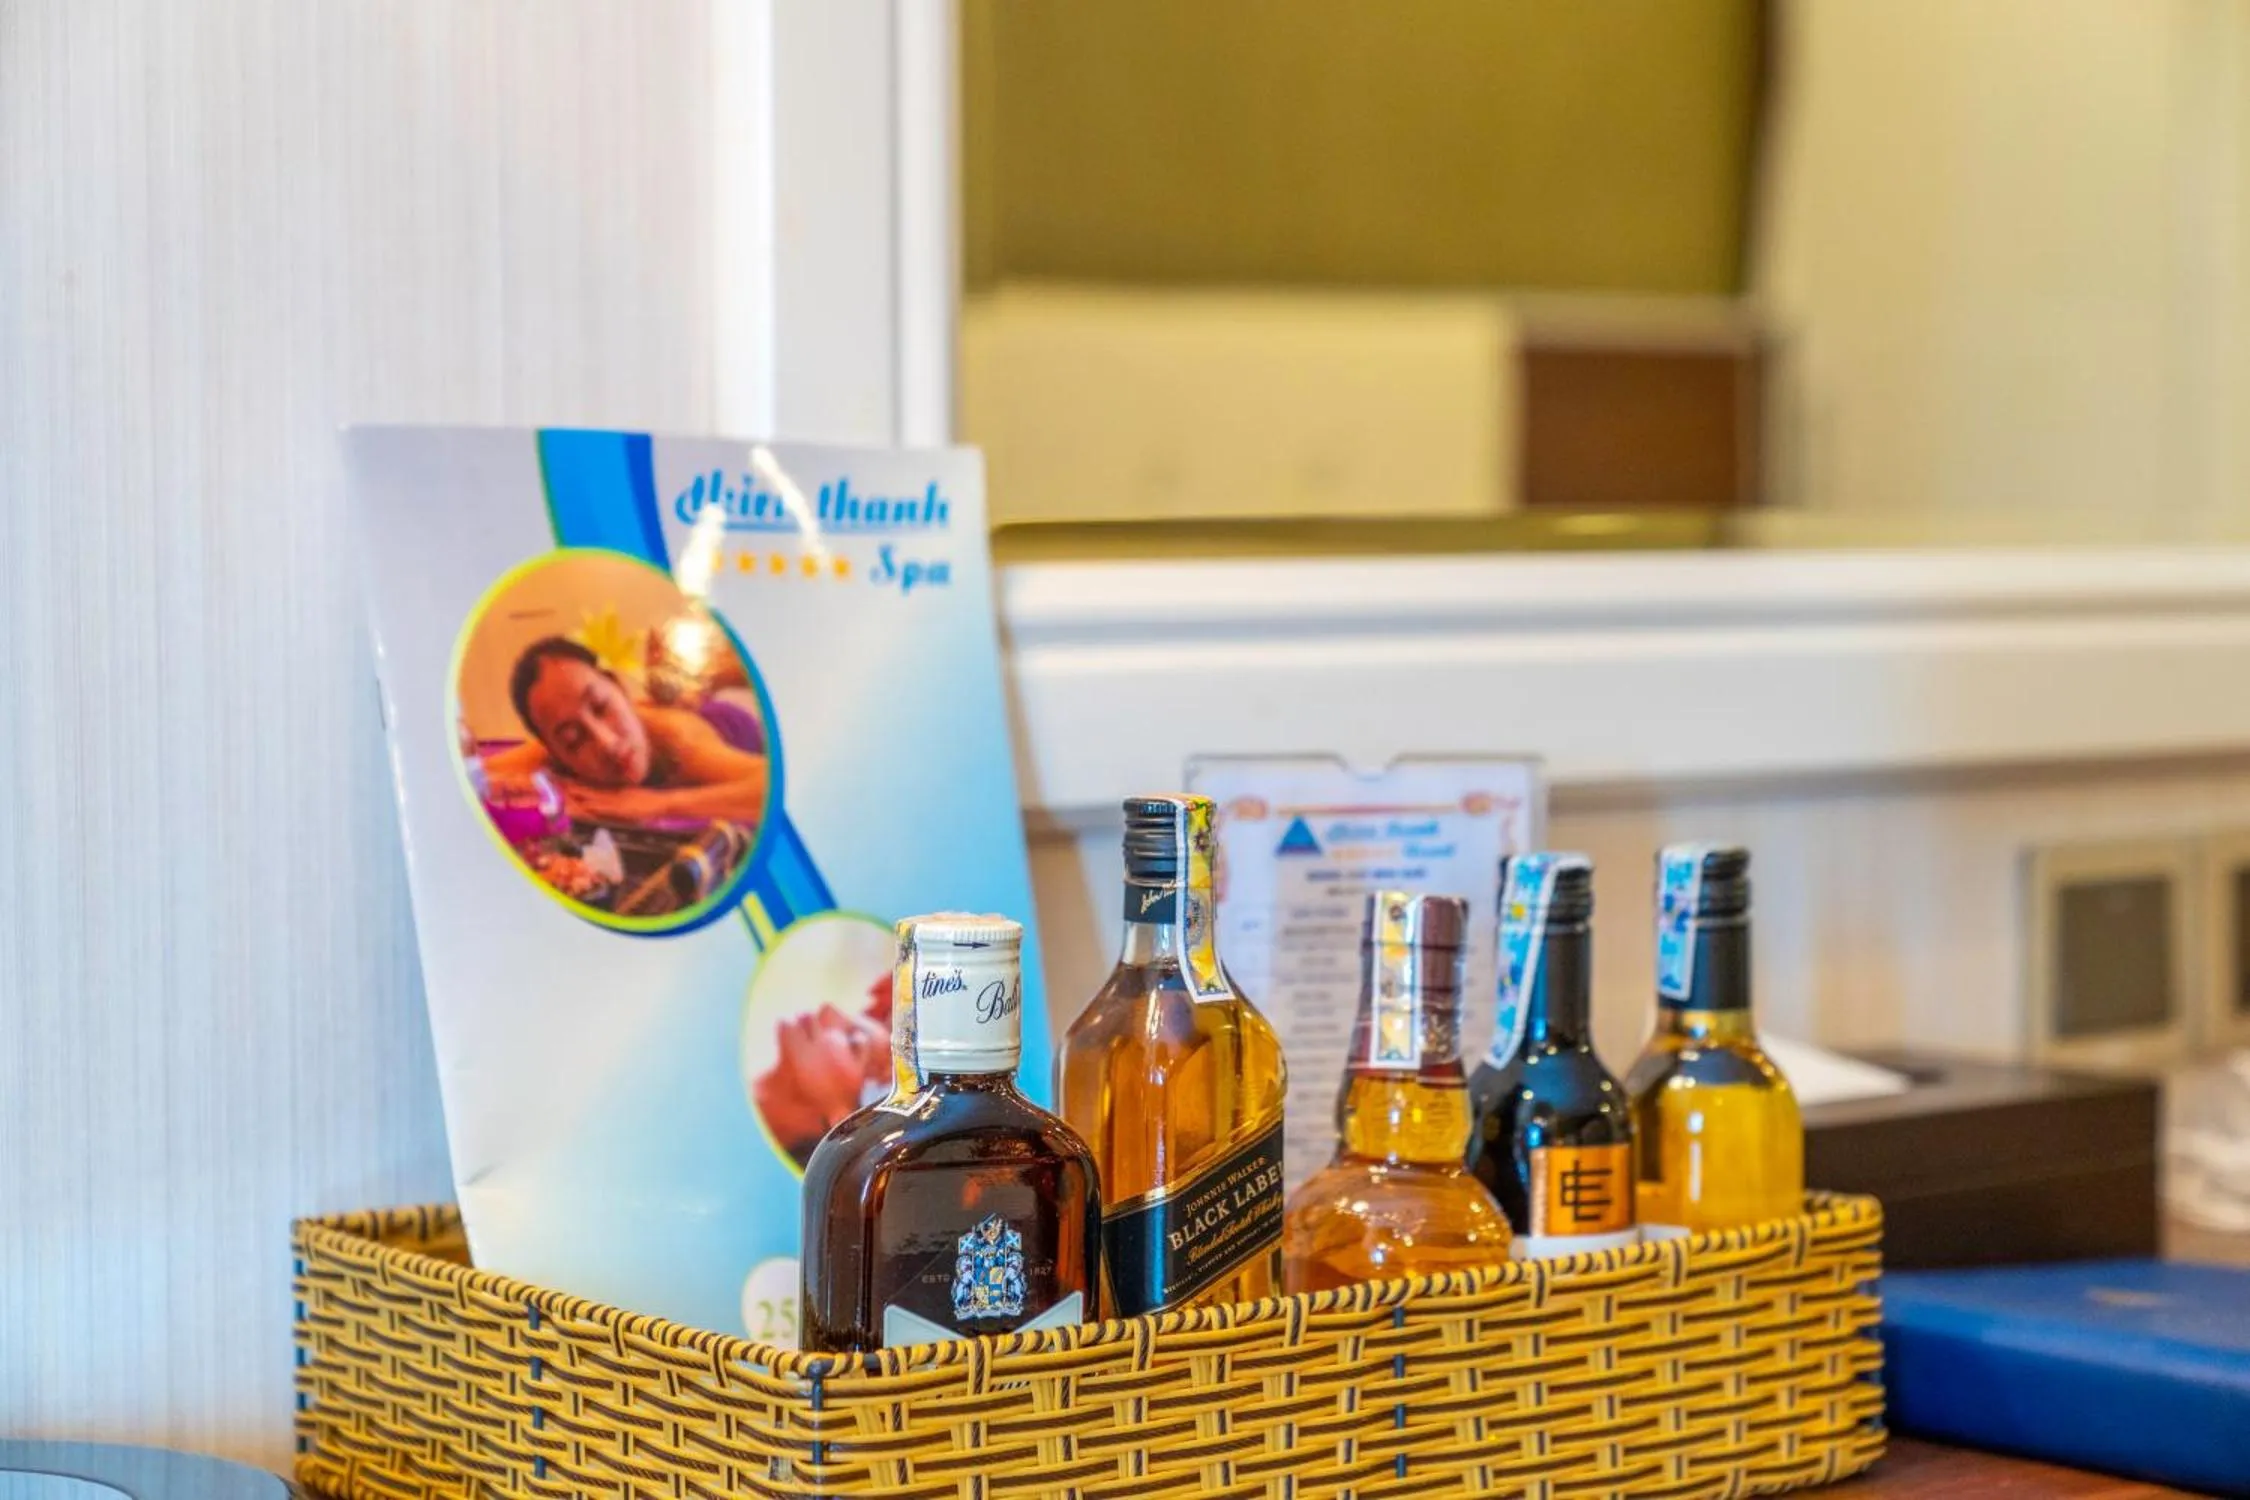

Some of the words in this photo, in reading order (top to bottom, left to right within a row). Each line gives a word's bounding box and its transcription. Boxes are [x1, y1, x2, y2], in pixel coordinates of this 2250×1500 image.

[868, 544, 950, 598] Spa
[1227, 1157, 1266, 1186] WALKER
[1166, 1198, 1231, 1250] BLACK
